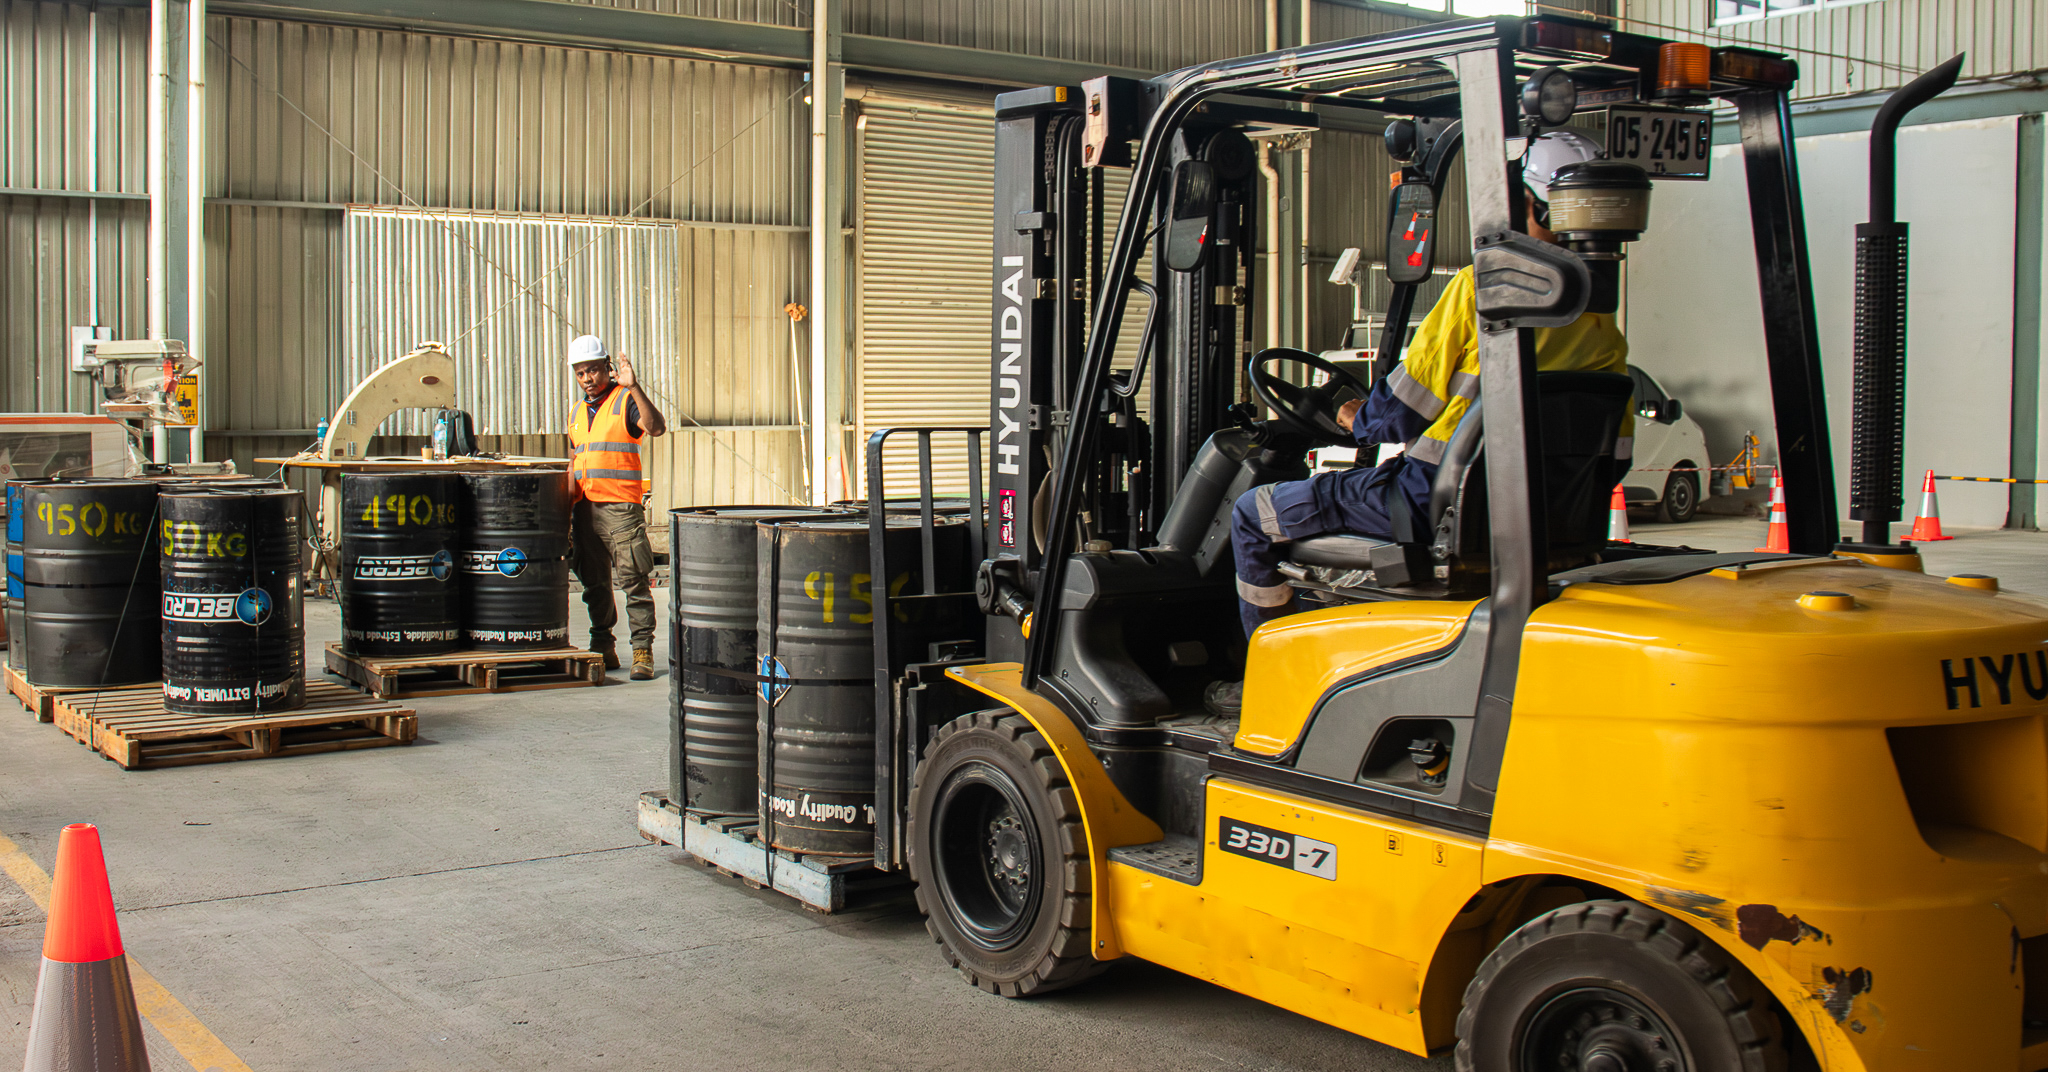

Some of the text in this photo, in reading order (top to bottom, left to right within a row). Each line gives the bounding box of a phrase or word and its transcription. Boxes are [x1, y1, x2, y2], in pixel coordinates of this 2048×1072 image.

[997, 255, 1024, 475] HYUNDAI
[37, 501, 142, 537] 950 KG
[361, 494, 455, 529] 490 KG
[206, 532, 248, 557] KG
[360, 558, 432, 577] BECRO
[164, 595, 236, 618] BECRO
[366, 630, 401, 642] Estrada
[403, 629, 444, 642] Kualidade,
[508, 630, 542, 642] Estrada
[193, 686, 251, 702] BITUMEN,
[254, 679, 284, 698] uality
[799, 793, 857, 824] Quality
